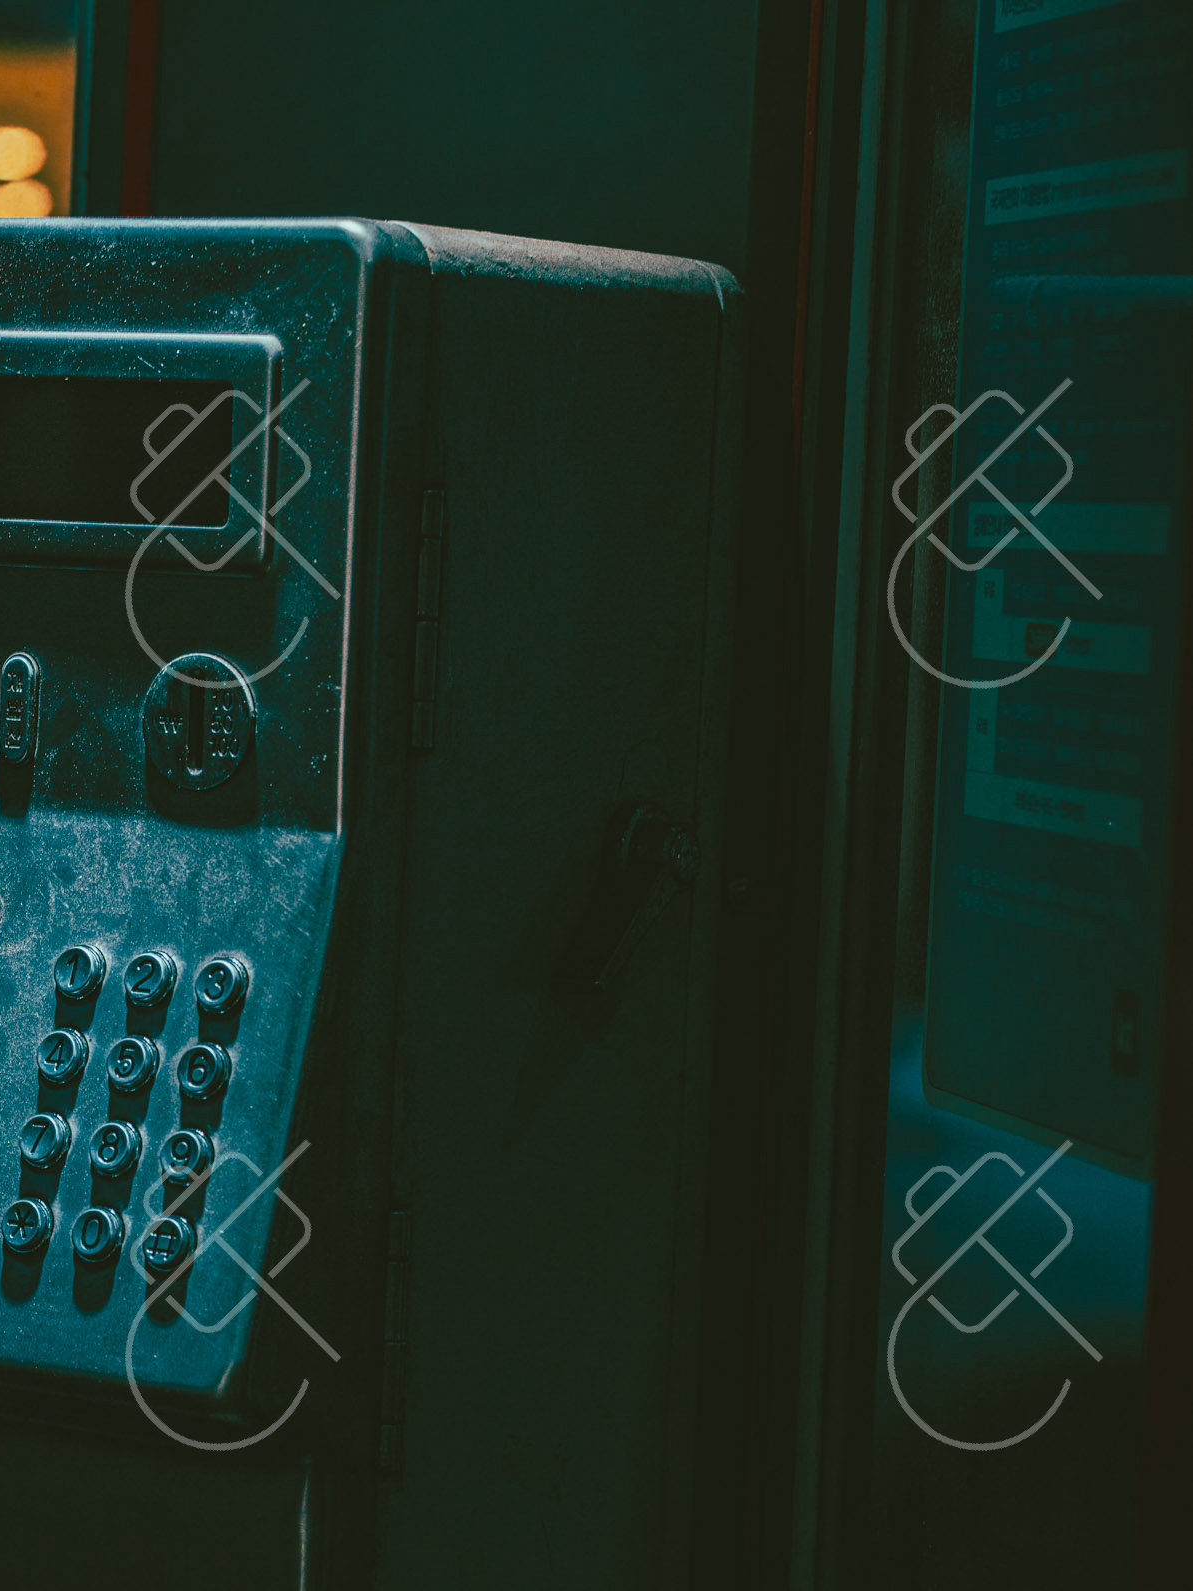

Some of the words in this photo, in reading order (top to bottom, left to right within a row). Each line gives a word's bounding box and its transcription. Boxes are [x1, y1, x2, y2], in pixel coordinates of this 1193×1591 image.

[211, 691, 233, 712] 10
[210, 714, 234, 735] 50
[209, 737, 240, 759] 100
[66, 955, 79, 987] 1
[131, 961, 156, 993] 2
[204, 969, 225, 999] 3
[45, 1039, 65, 1073] 4
[117, 1047, 137, 1077] 5
[188, 1054, 207, 1085] 6
[31, 1123, 50, 1154] 7
[100, 1130, 118, 1162] 8
[170, 1138, 192, 1169] 9
[82, 1217, 102, 1249] 0
